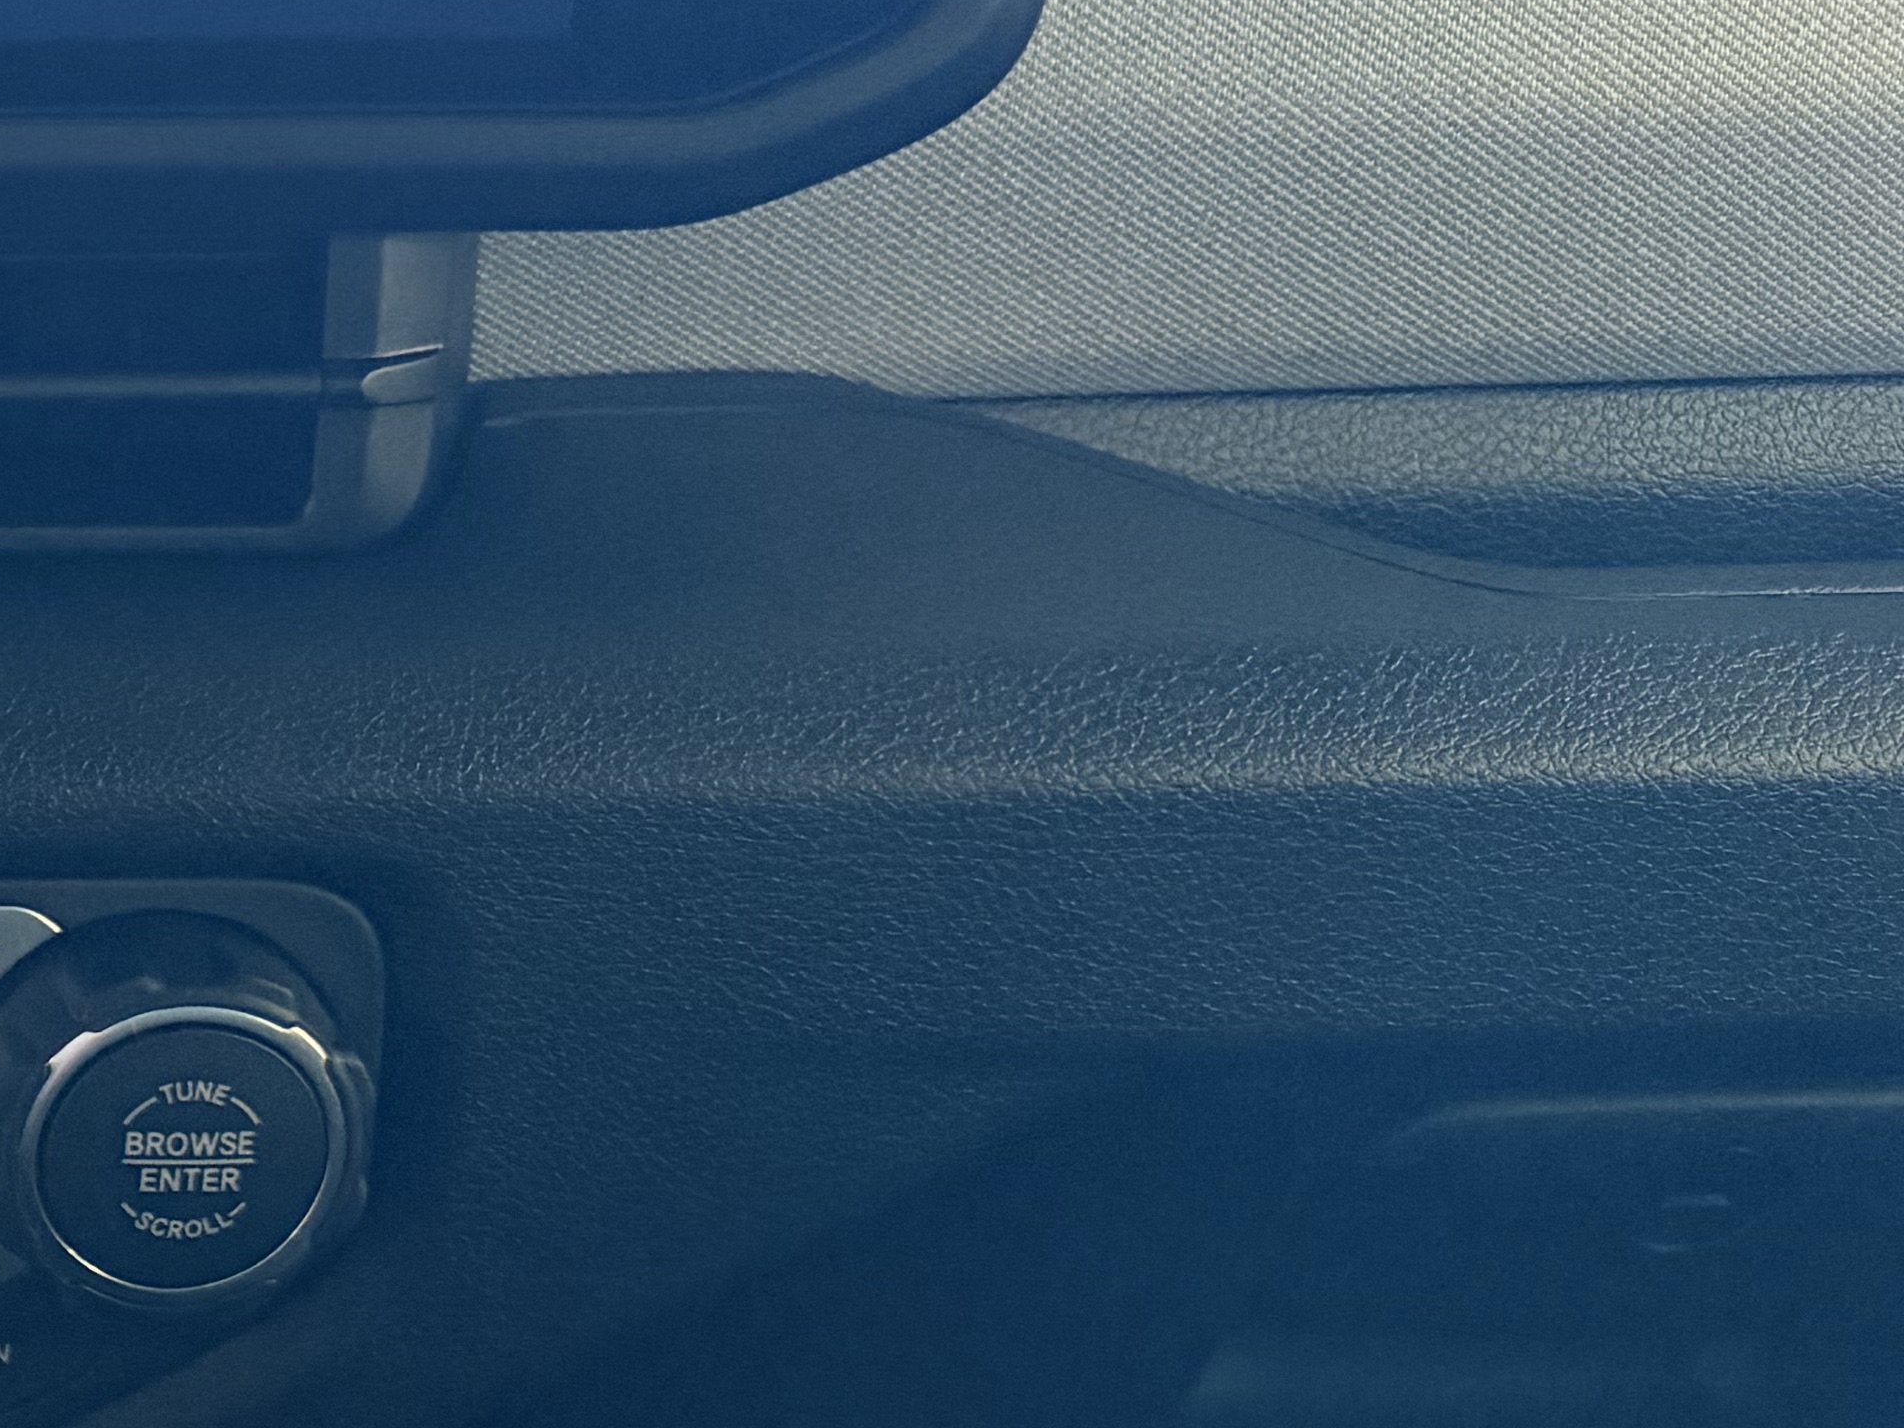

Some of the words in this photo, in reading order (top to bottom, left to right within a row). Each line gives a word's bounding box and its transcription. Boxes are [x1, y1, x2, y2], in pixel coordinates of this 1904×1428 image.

[157, 1079, 232, 1107] TUNE
[124, 1130, 255, 1158] BROWSE
[138, 1167, 241, 1193] ENTER
[133, 1209, 233, 1239] SCROLL
